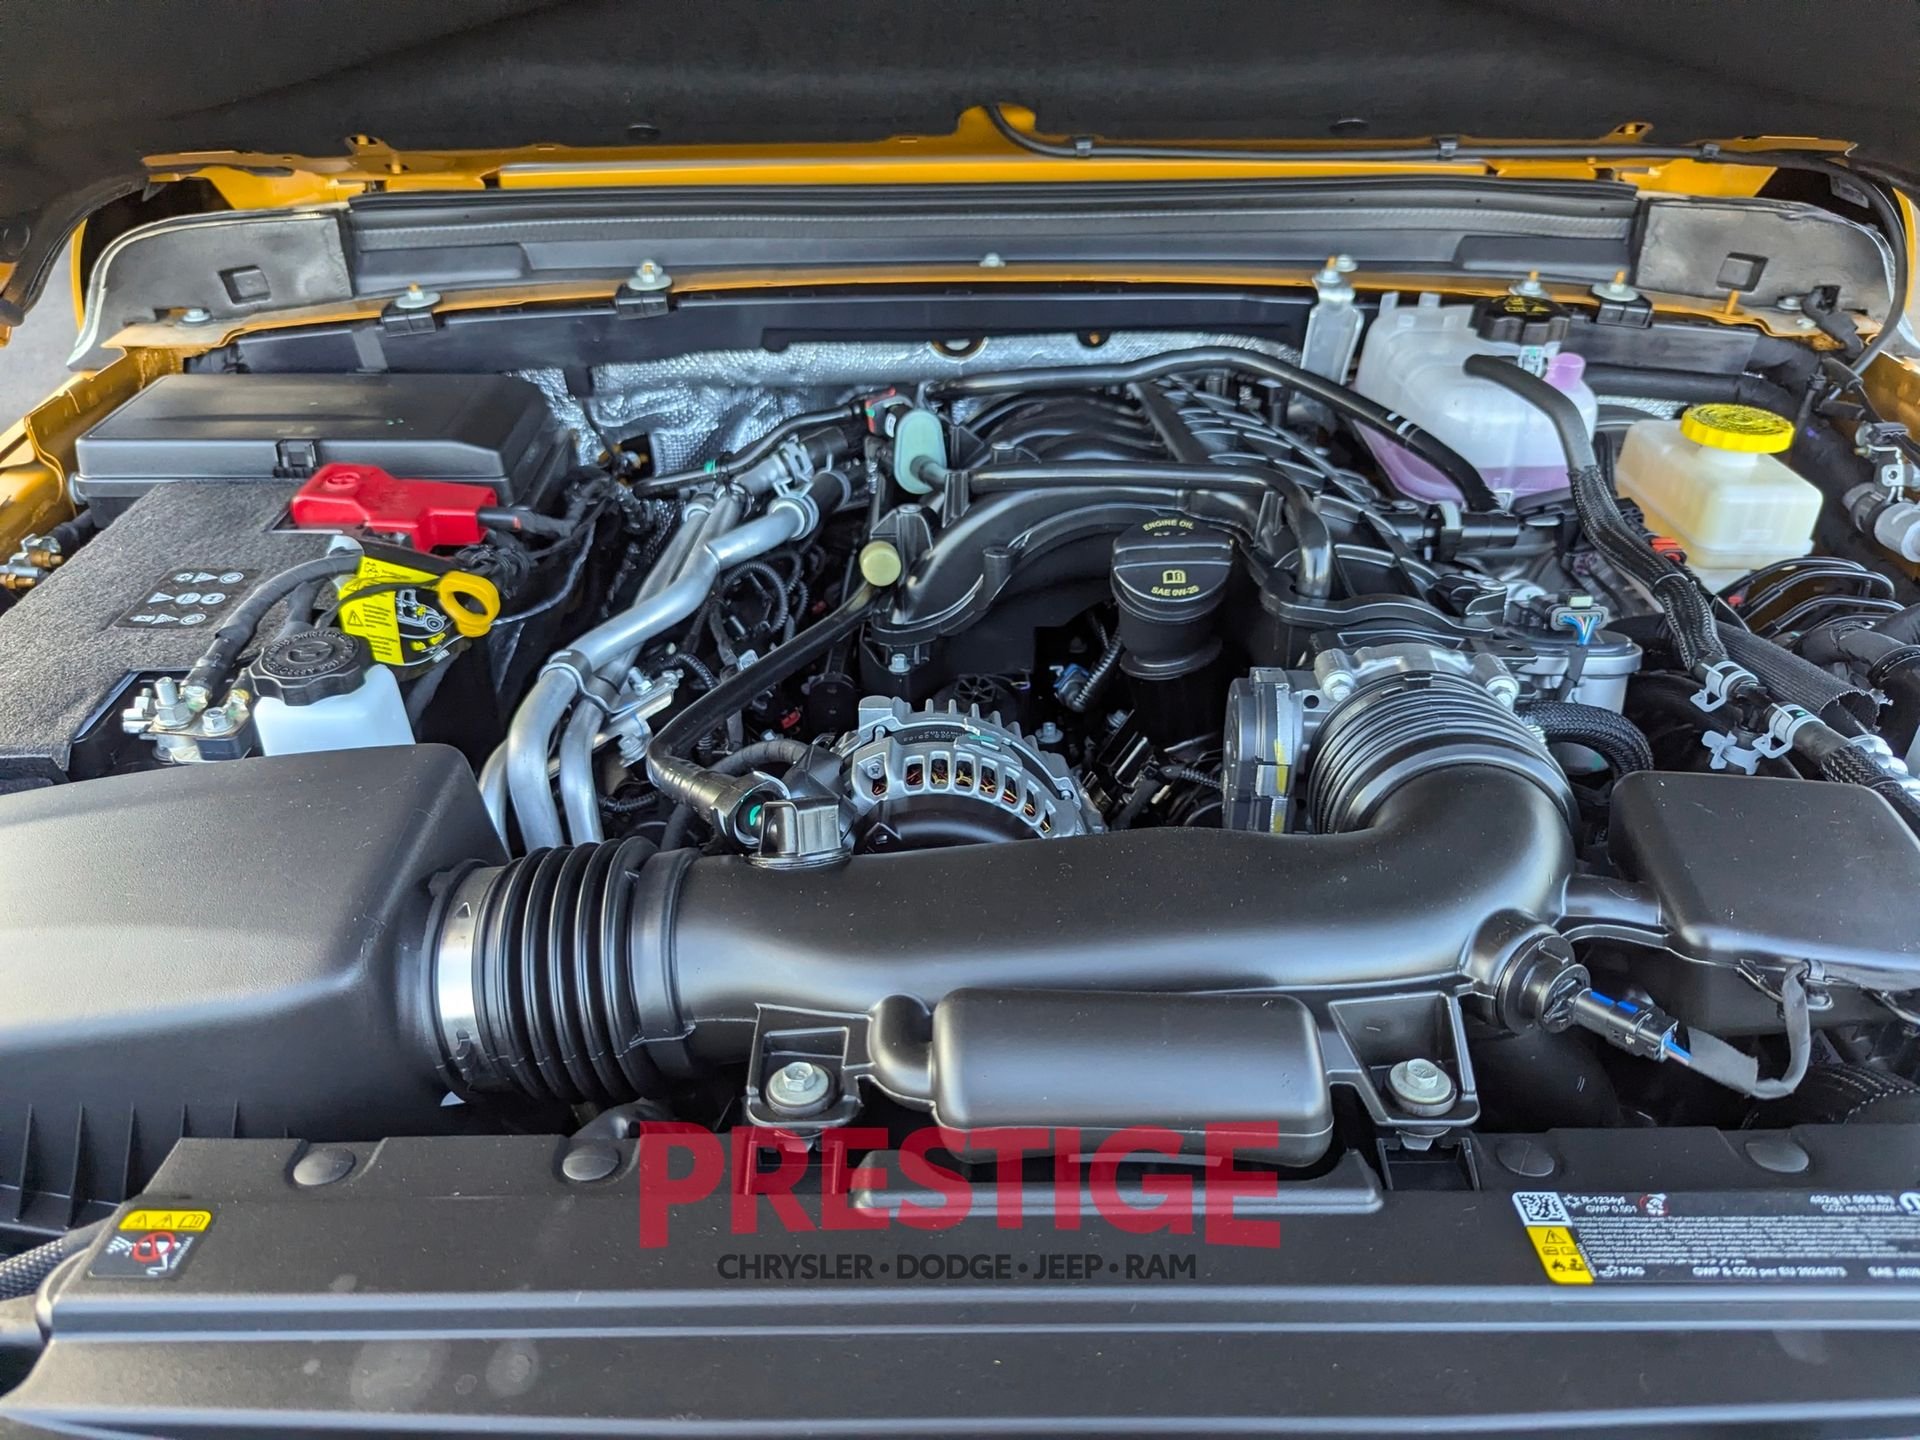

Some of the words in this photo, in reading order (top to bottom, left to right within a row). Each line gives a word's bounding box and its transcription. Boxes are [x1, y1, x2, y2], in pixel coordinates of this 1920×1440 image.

[1142, 519, 1178, 531] ENGINE
[1179, 520, 1194, 530] OIL
[1151, 586, 1170, 596] SAE
[1172, 585, 1200, 597] 0W-20
[1585, 1204, 1610, 1214] GWP
[1620, 1266, 1646, 1277] PAG
[1692, 1266, 1720, 1277] GWP
[1732, 1267, 1758, 1277] CO2
